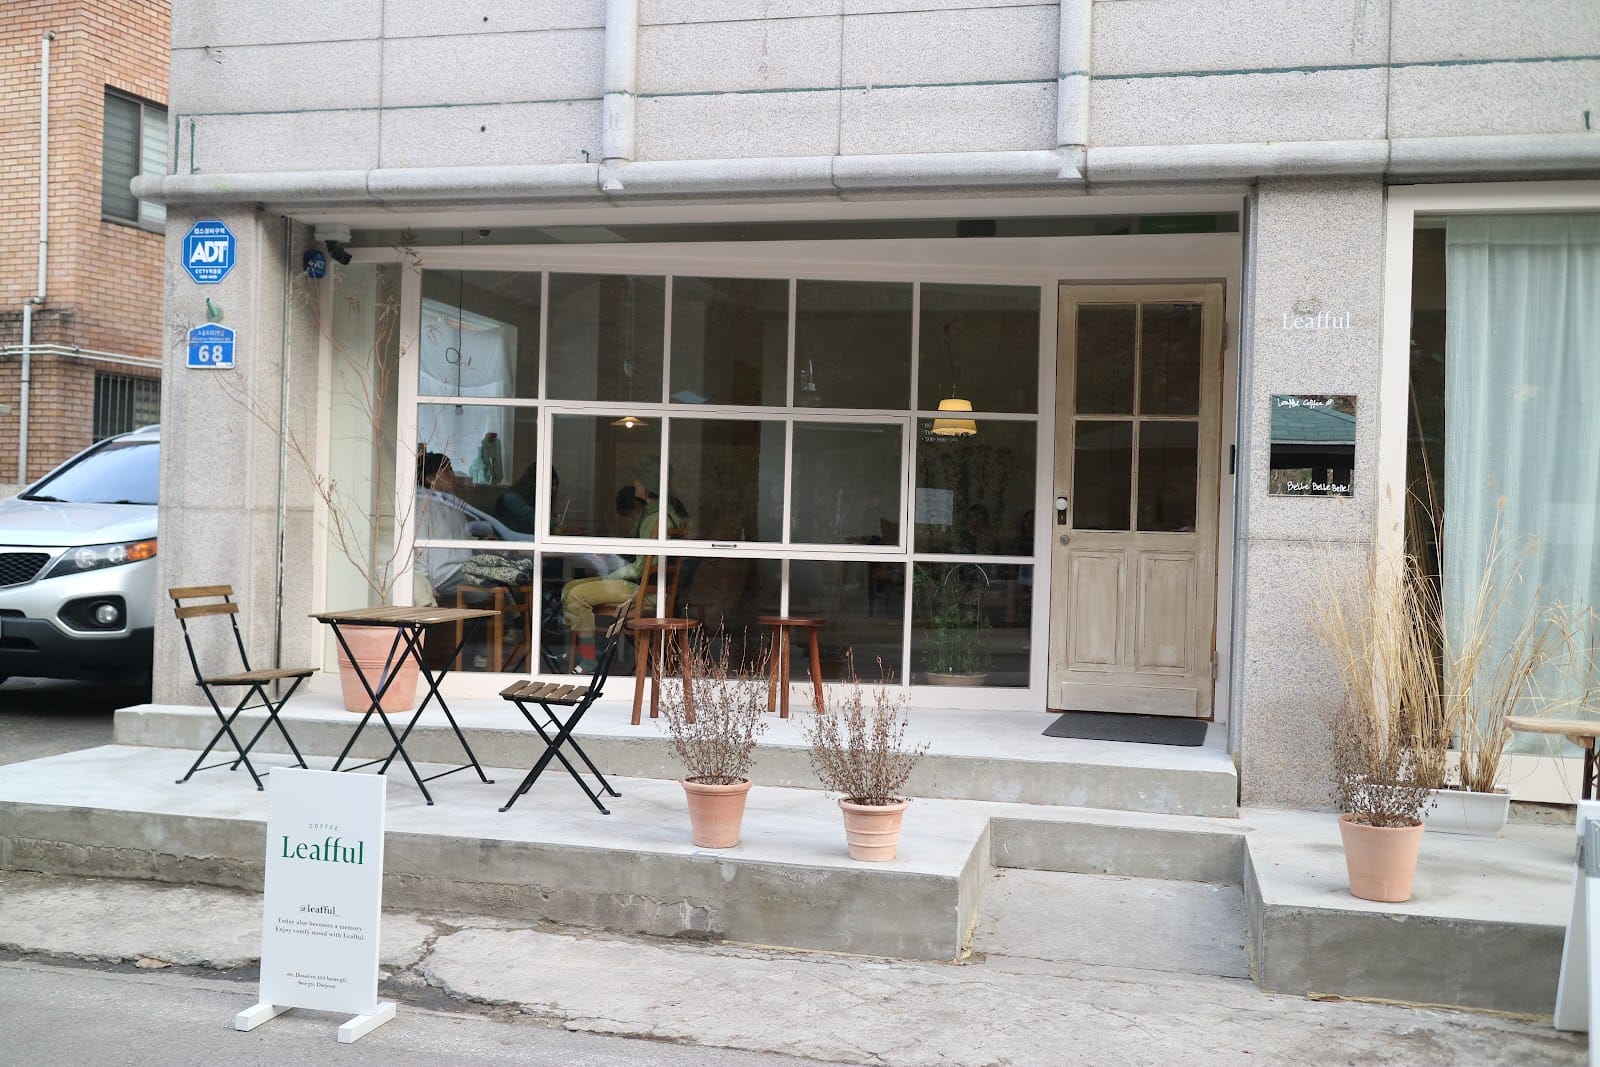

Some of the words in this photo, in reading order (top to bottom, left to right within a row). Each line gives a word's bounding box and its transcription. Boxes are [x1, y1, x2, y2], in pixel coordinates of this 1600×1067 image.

[191, 240, 229, 263] ADT
[1283, 310, 1351, 330] Leafful
[198, 345, 224, 362] 68
[1287, 480, 1310, 491] Belle
[1312, 482, 1331, 491] Belle
[309, 823, 339, 831] COFFEE
[281, 835, 364, 864] Leafful
[275, 926, 291, 934] Enjoy
[292, 928, 310, 936] comfy
[340, 924, 362, 932] memory
